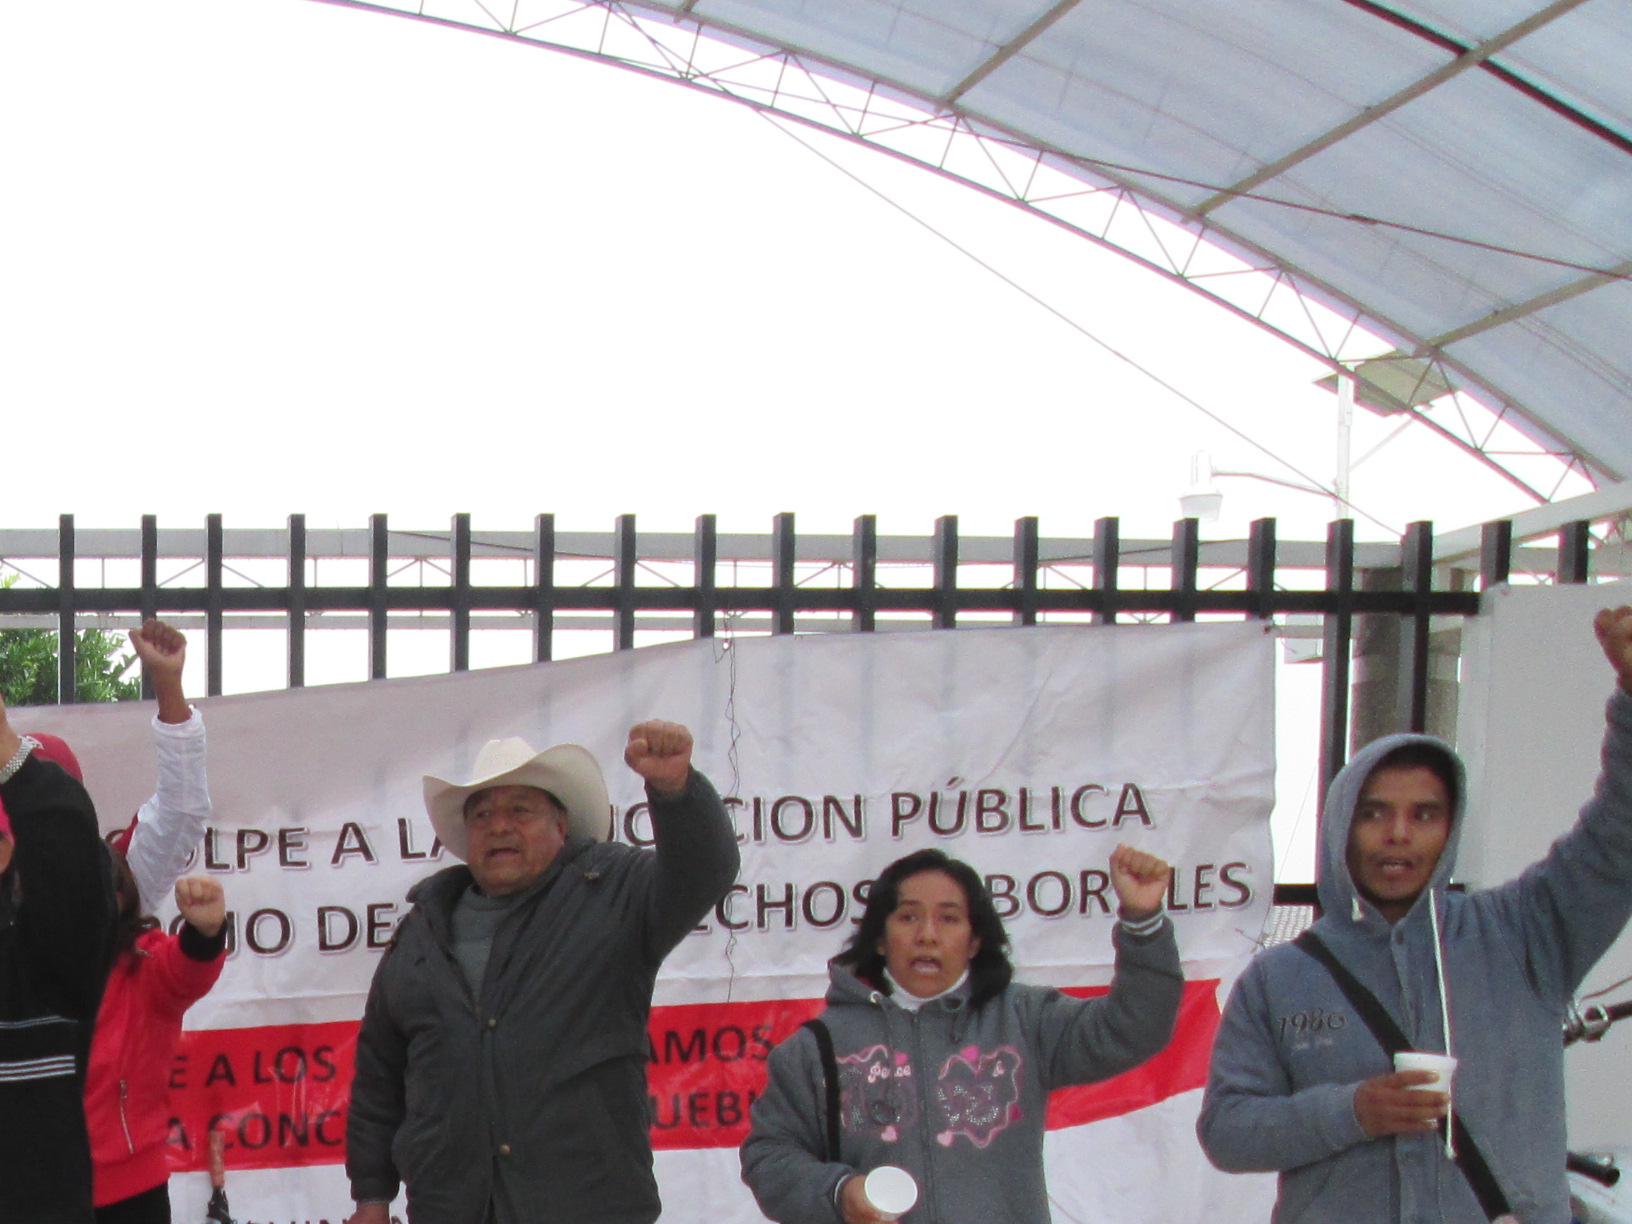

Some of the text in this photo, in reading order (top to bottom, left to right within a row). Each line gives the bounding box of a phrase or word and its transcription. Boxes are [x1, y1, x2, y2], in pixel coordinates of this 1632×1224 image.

[331, 822, 378, 866] A
[890, 776, 1154, 839] PÚBLICA
[206, 1053, 237, 1087] A
[254, 1045, 337, 1084] LOS
